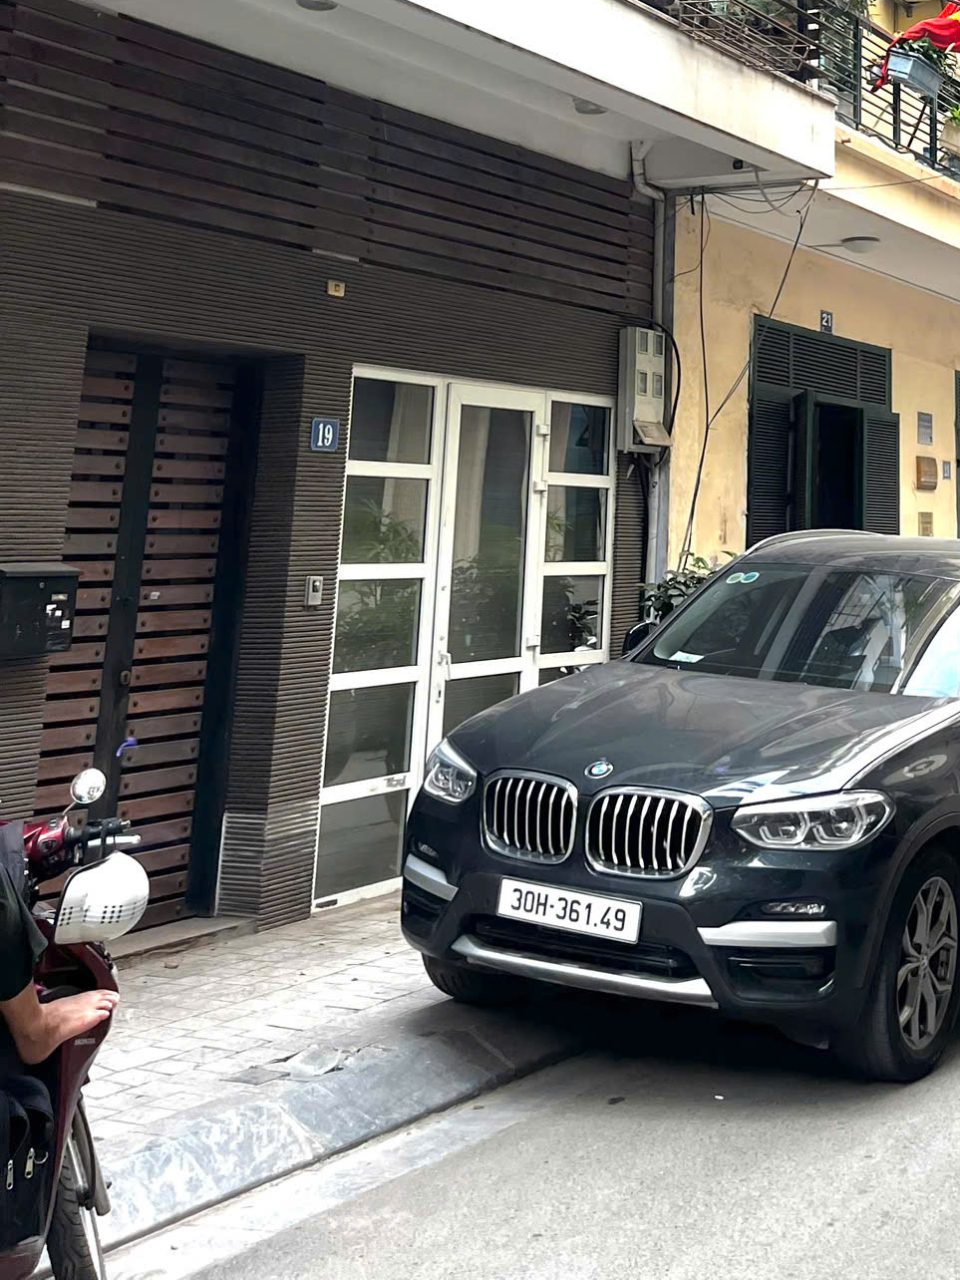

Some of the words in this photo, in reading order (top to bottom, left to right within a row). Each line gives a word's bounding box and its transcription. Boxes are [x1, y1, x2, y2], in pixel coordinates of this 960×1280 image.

[822, 313, 831, 327] 21
[317, 423, 333, 447] 19
[510, 887, 626, 932] 30H-361.49
